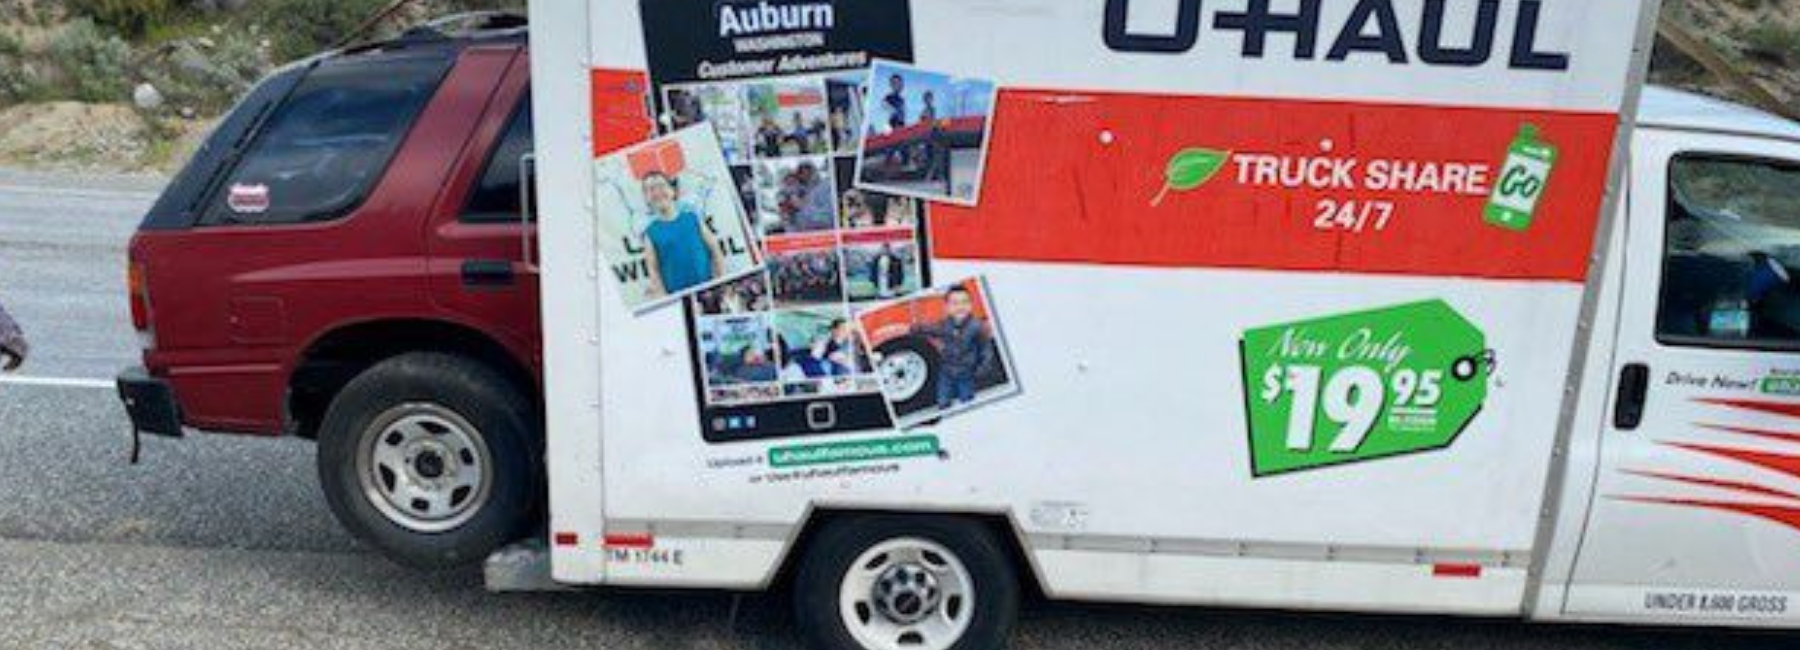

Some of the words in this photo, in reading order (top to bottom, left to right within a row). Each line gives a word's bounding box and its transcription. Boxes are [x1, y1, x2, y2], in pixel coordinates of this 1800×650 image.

[719, 1, 834, 37] Auburn
[1102, 0, 1569, 71] U-HAUL
[697, 59, 775, 79] Customer
[776, 50, 867, 73] Adventures
[1233, 154, 1355, 189] TRUCK
[1364, 159, 1491, 196] SHARE
[1314, 200, 1395, 233] 24/7
[1267, 328, 1327, 359] Now
[1338, 328, 1412, 372] Only
[1665, 371, 1708, 387] Drive
[1644, 593, 1695, 610] UNDER
[1737, 595, 1788, 613] GROSS
